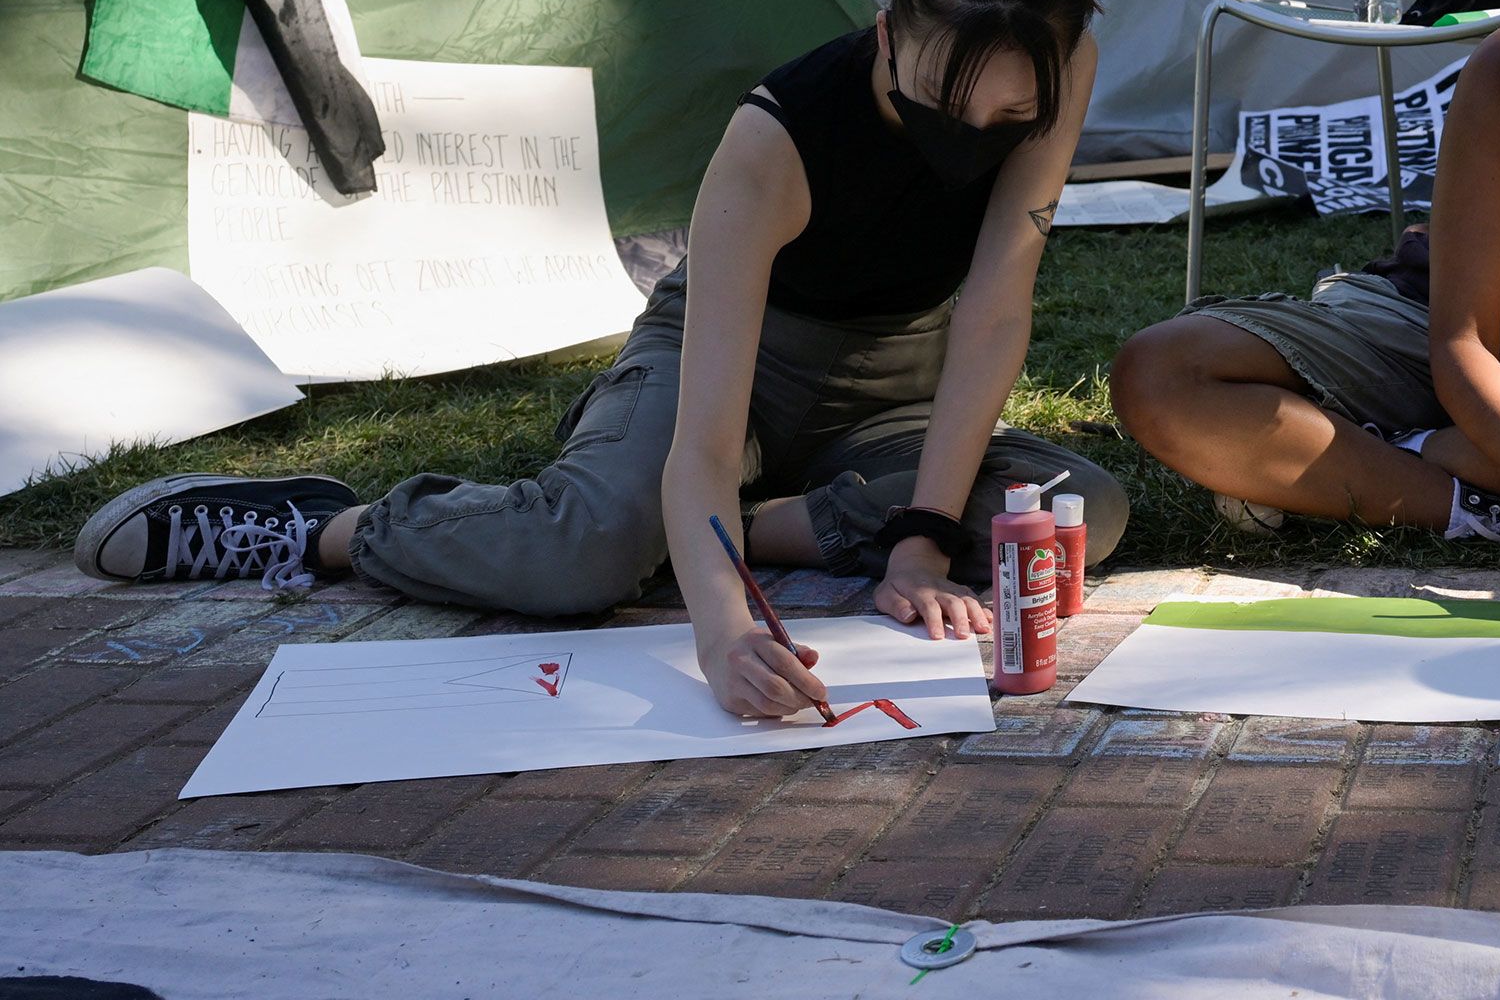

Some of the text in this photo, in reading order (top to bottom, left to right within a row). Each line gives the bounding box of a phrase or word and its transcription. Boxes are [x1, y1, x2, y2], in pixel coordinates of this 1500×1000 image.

[212, 122, 293, 163] HAVING
[416, 132, 509, 169] INTEREST
[519, 136, 543, 170] IN
[549, 135, 583, 172] THE
[211, 161, 560, 208] GENOCIDE THE PALESTINIAN
[214, 206, 293, 242] PEOPLE
[355, 258, 399, 297] OFF
[417, 255, 497, 293] ZIONIST
[1032, 595, 1049, 604] Bright
[1193, 796, 1242, 835] RAJESH
[1052, 834, 1116, 884] DIAMOND
